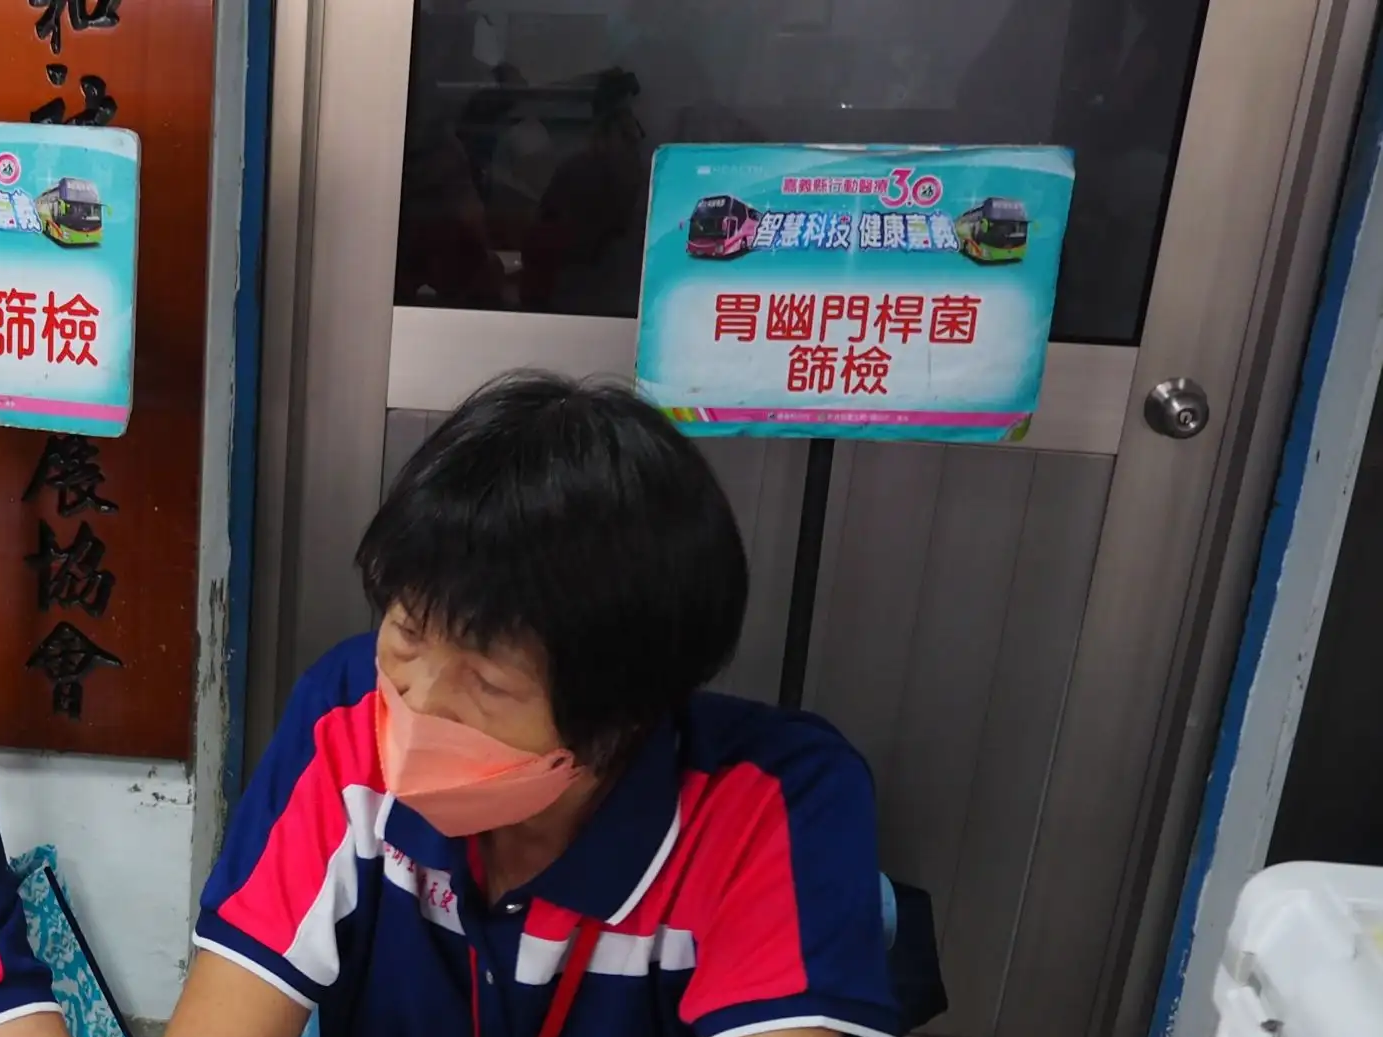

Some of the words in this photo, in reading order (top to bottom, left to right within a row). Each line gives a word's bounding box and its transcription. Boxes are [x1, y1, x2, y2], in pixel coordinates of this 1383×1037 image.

[752, 212, 852, 251] 智慧科技
[858, 211, 960, 251] 健康嘉義
[714, 293, 982, 345] 胃幽門桿菌
[786, 344, 893, 395] 篩檢
